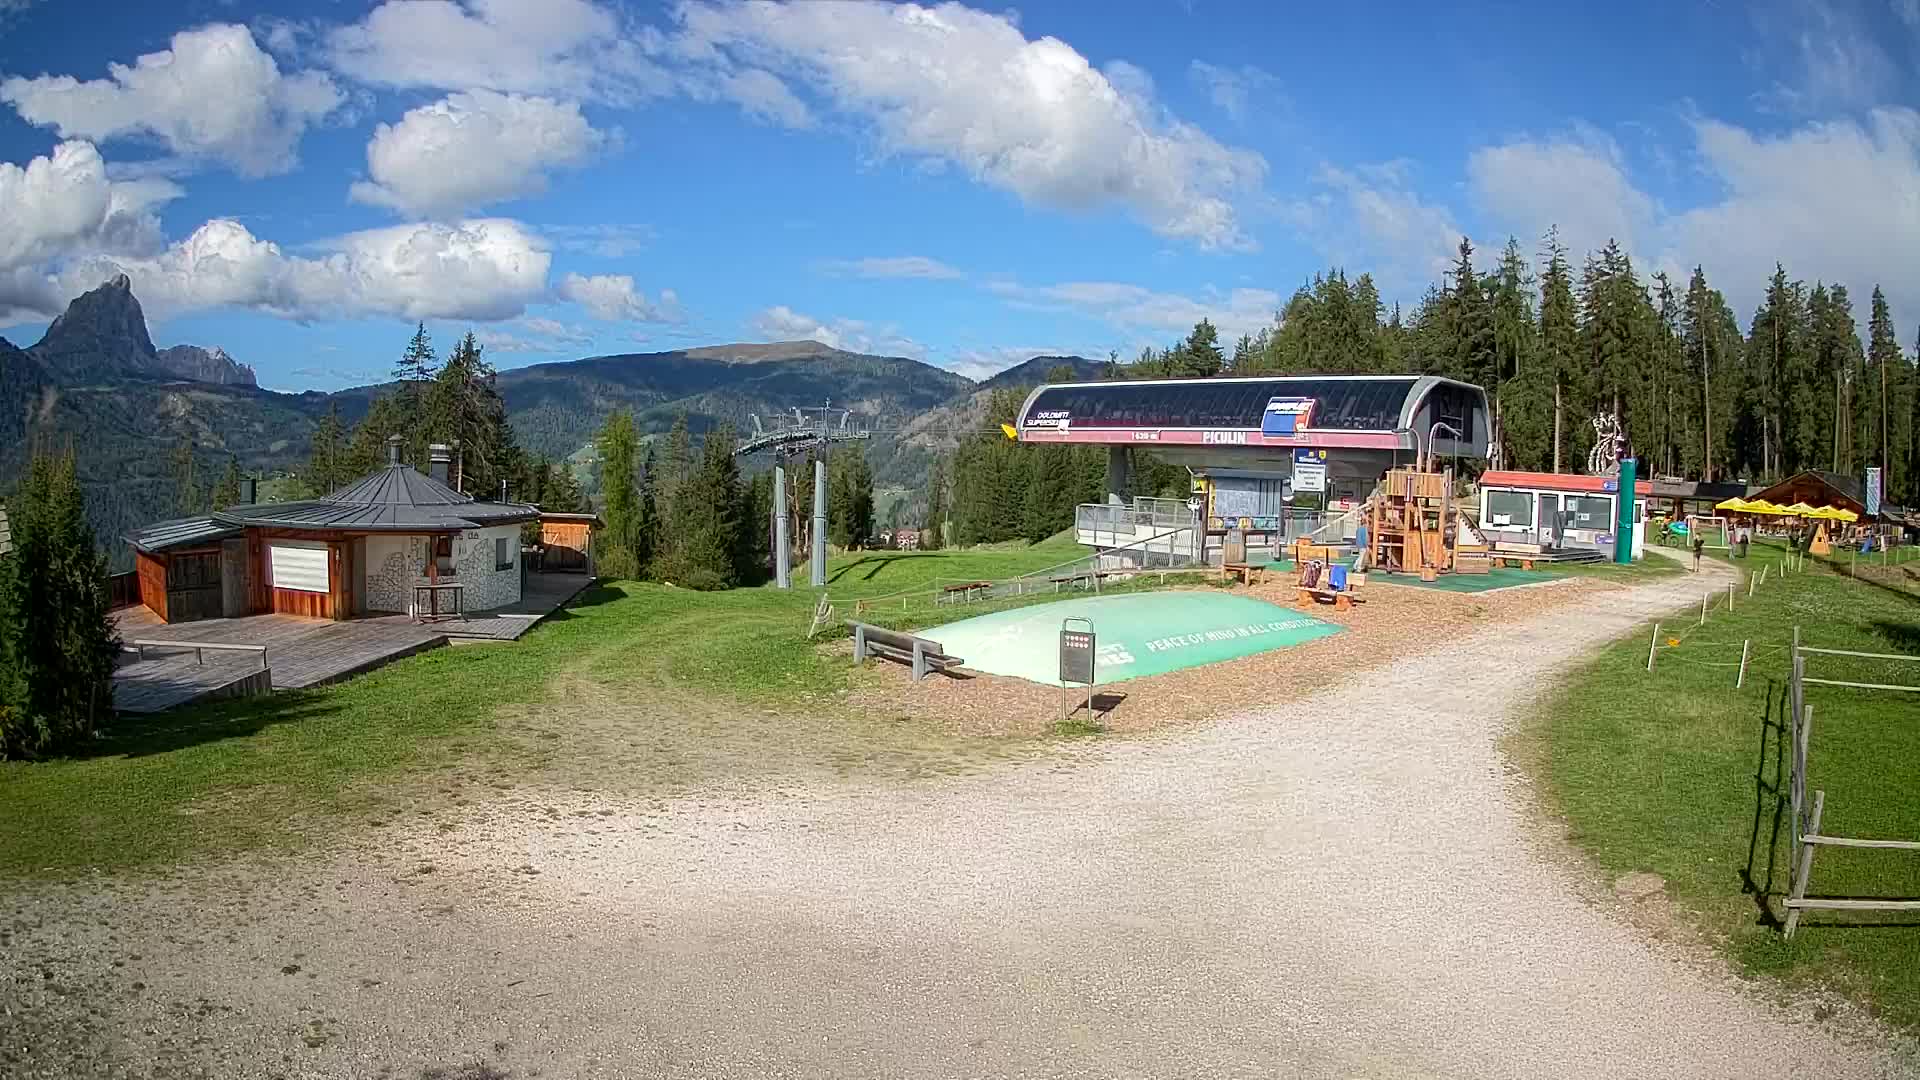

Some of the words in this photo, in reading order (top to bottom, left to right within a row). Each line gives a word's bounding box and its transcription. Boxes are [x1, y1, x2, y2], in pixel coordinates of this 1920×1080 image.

[1202, 431, 1247, 444] PICULIN
[1145, 635, 1190, 652] PEACE
[1187, 631, 1206, 644] OF
